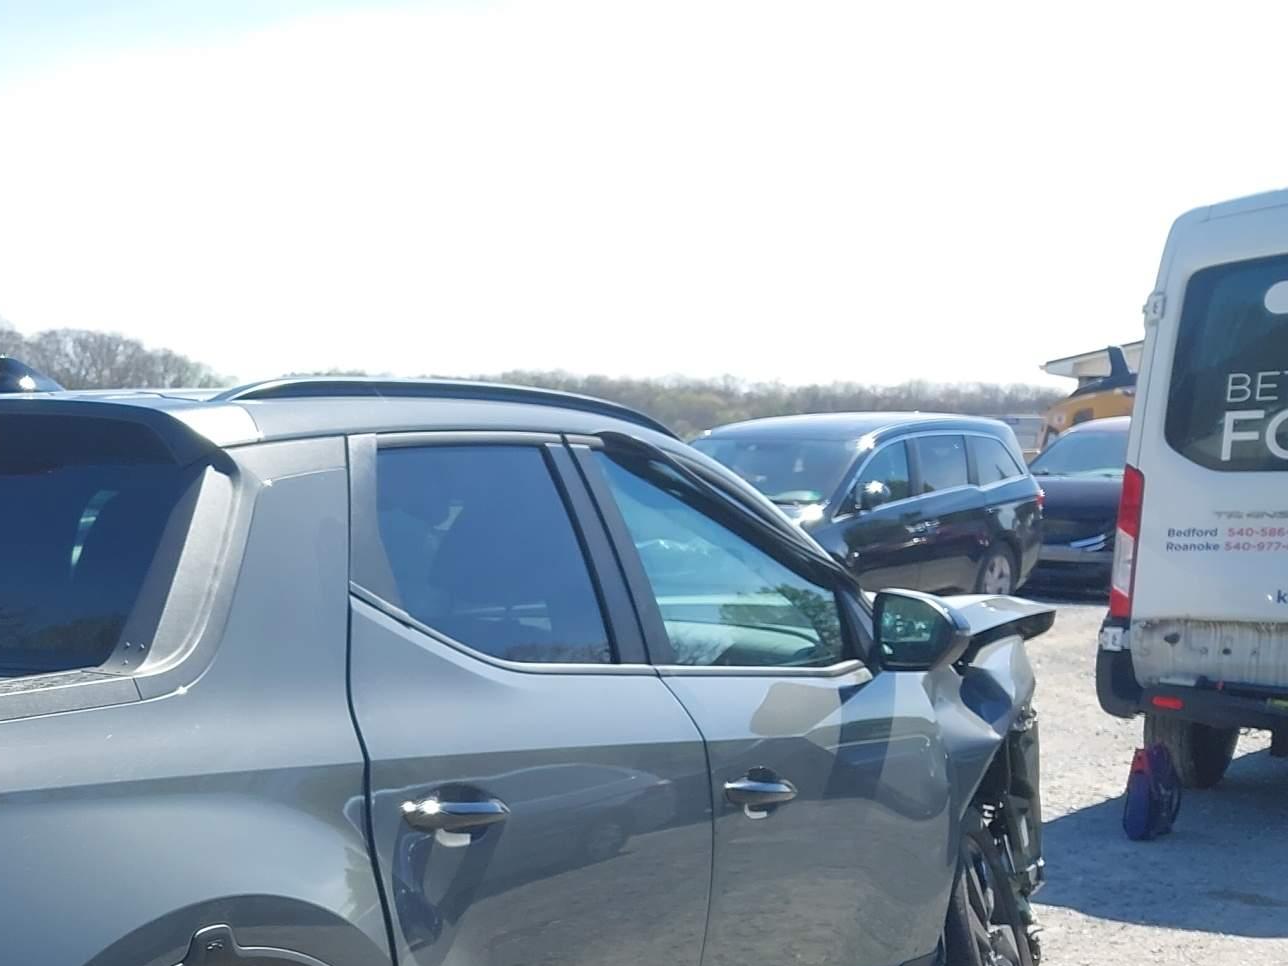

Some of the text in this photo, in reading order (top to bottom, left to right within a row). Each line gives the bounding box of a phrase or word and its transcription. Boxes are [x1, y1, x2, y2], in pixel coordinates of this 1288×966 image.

[1227, 371, 1288, 402] BE
[1167, 527, 1218, 538] Bedford
[1166, 541, 1288, 552] Roanoke 540-977-
